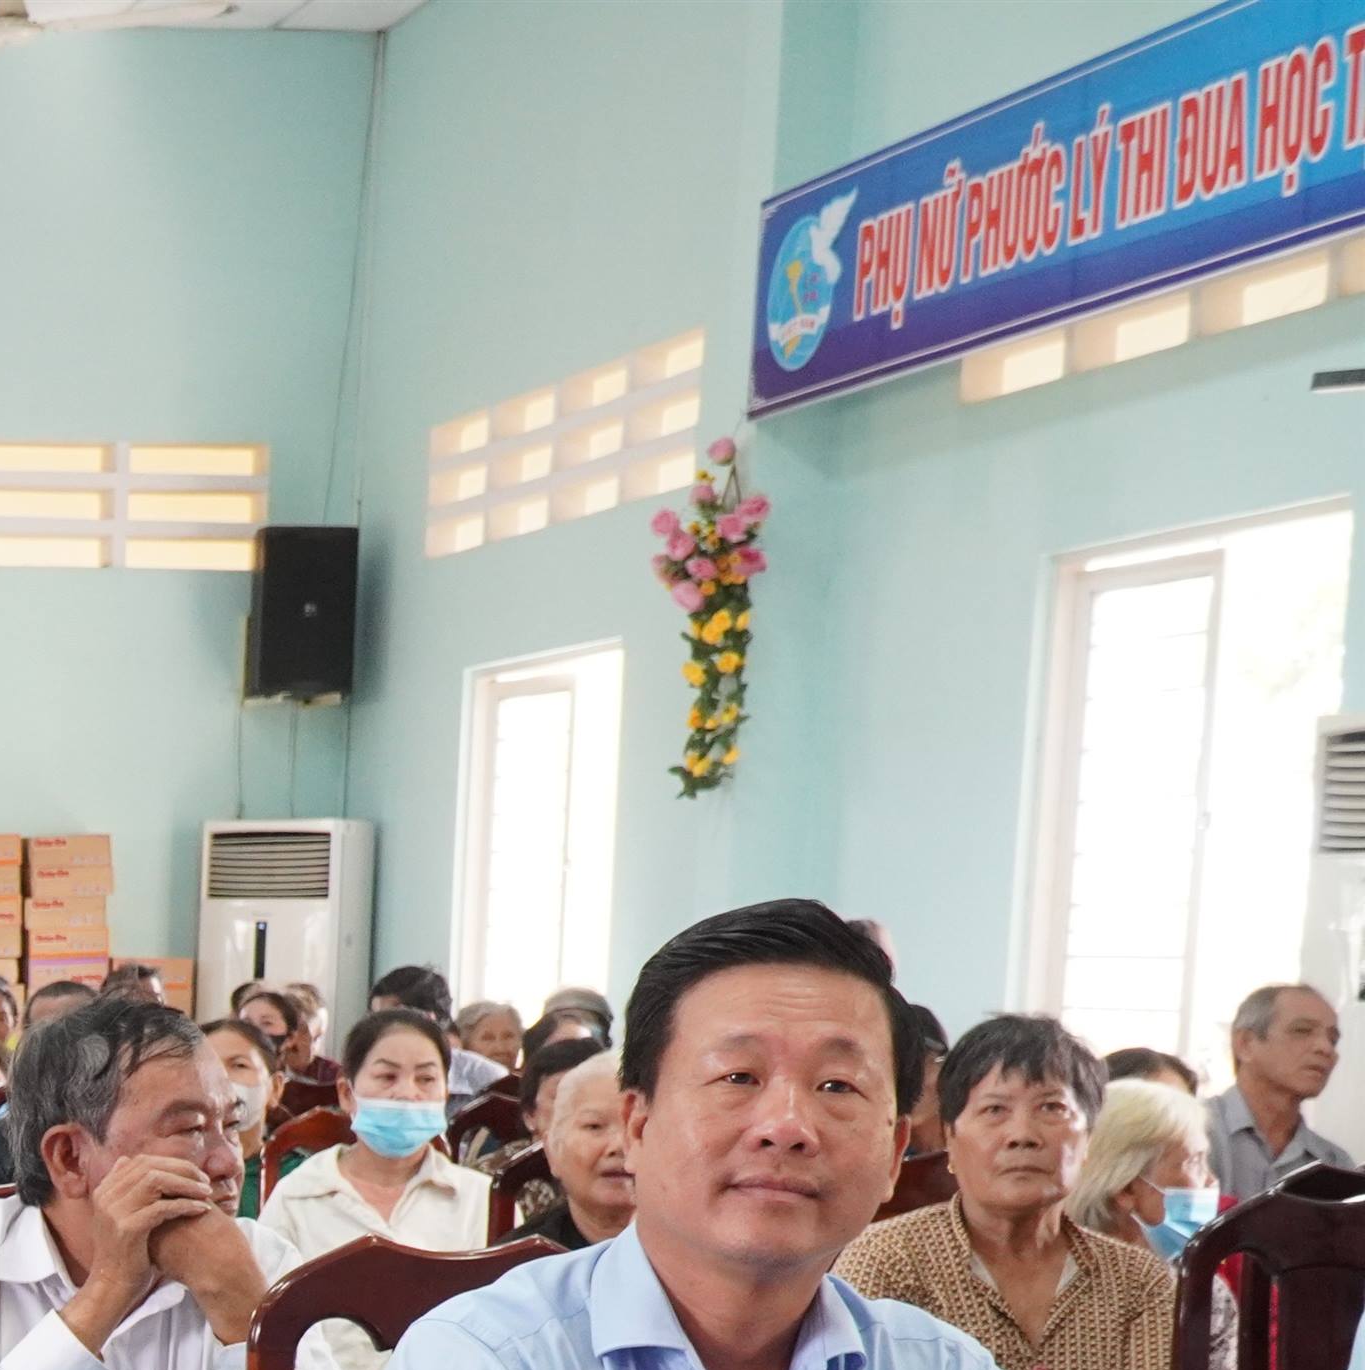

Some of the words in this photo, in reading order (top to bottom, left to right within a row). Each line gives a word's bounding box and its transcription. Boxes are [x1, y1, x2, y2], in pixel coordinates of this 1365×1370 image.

[853, 202, 915, 329] PHỤ
[913, 158, 967, 300] NỮ
[959, 120, 1067, 284] PHƯỚC
[1067, 102, 1113, 247] LÝ
[1115, 103, 1170, 230] THI
[1173, 73, 1247, 209] ĐUA
[1253, 35, 1335, 198] HỌC
